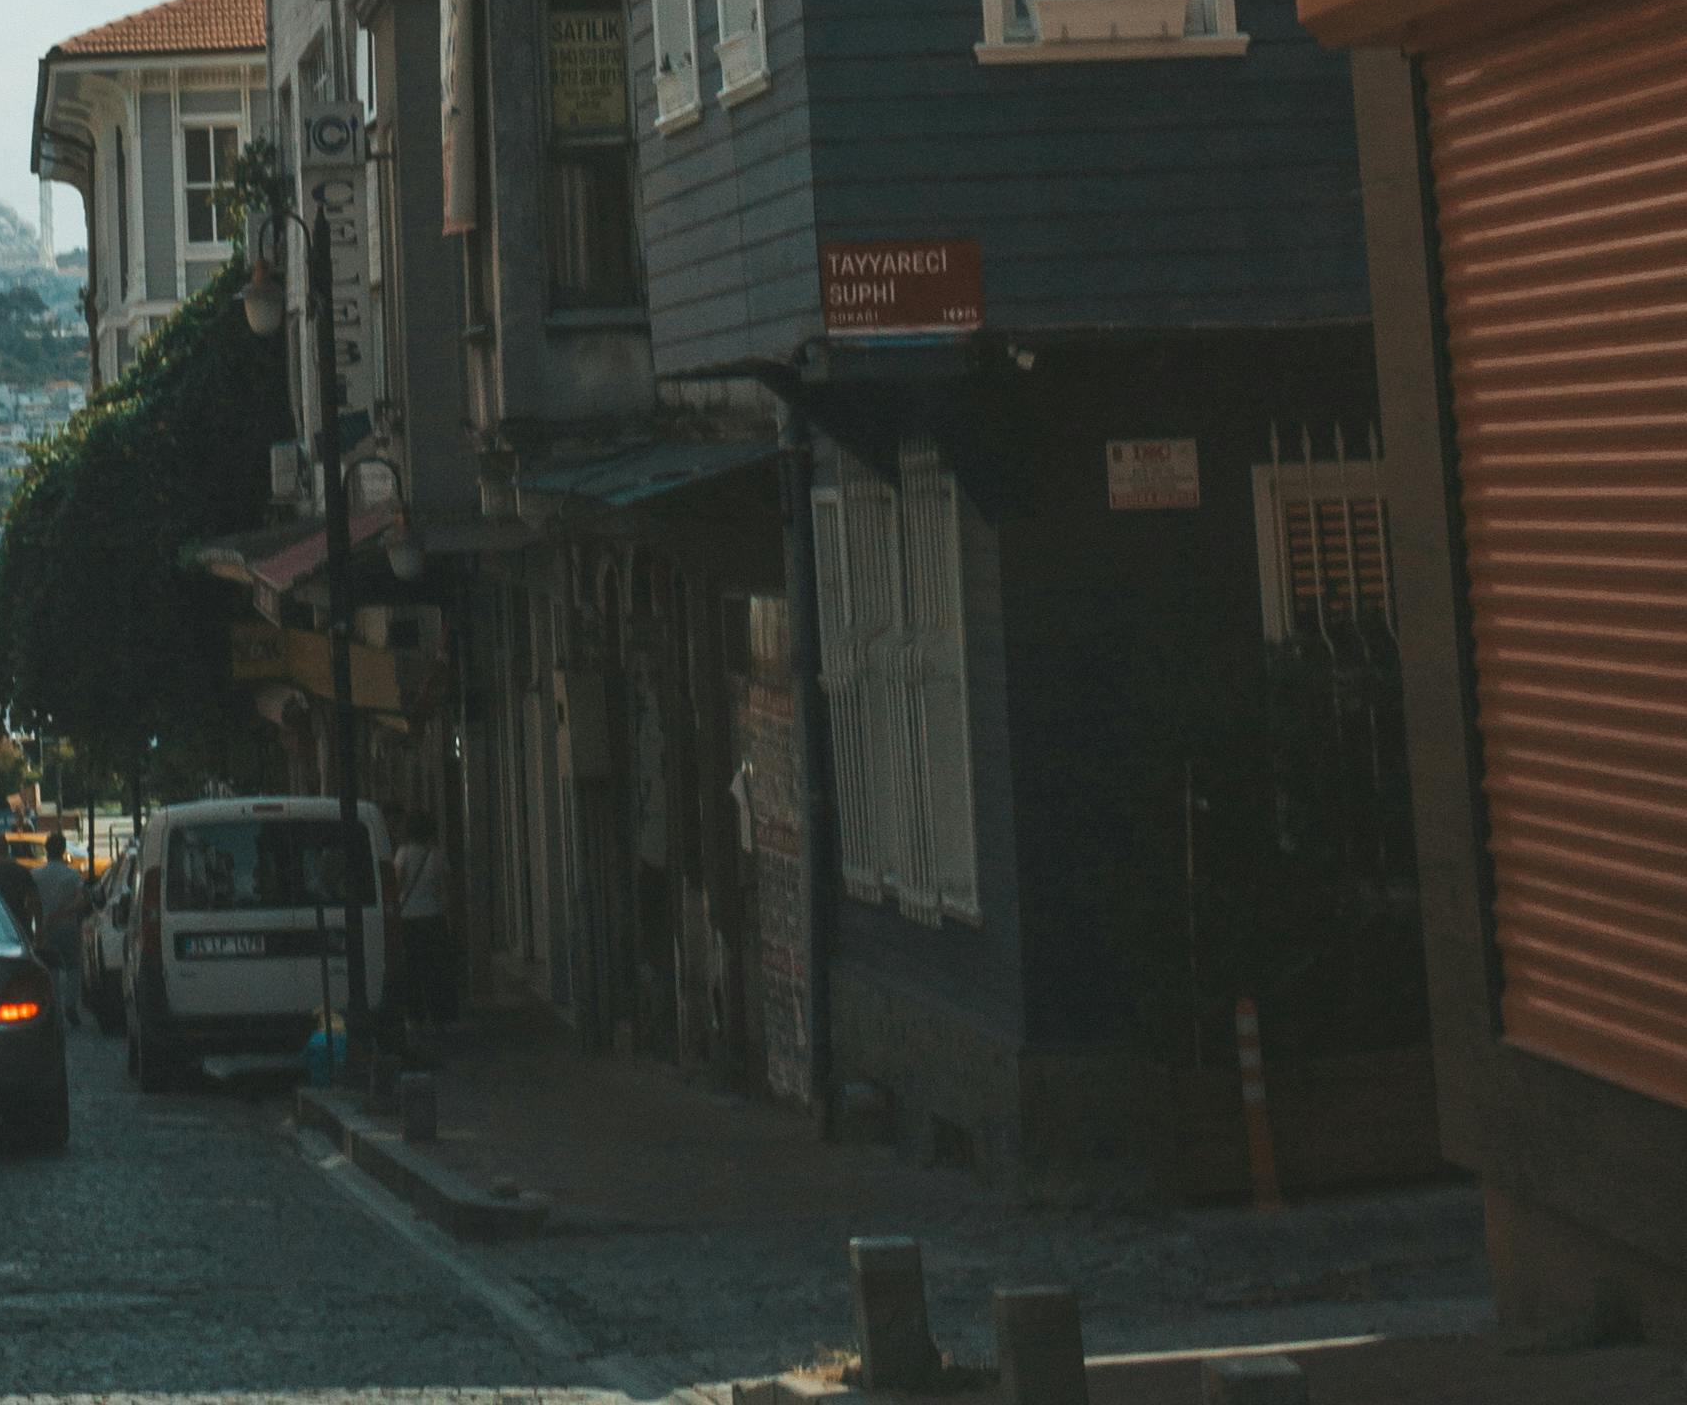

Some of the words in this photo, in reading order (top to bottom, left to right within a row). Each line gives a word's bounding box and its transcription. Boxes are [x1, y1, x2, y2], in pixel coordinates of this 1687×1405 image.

[551, 19, 620, 41] SATILIK
[828, 247, 947, 276] TAYYARECİ
[829, 277, 896, 306] SUPHİ
